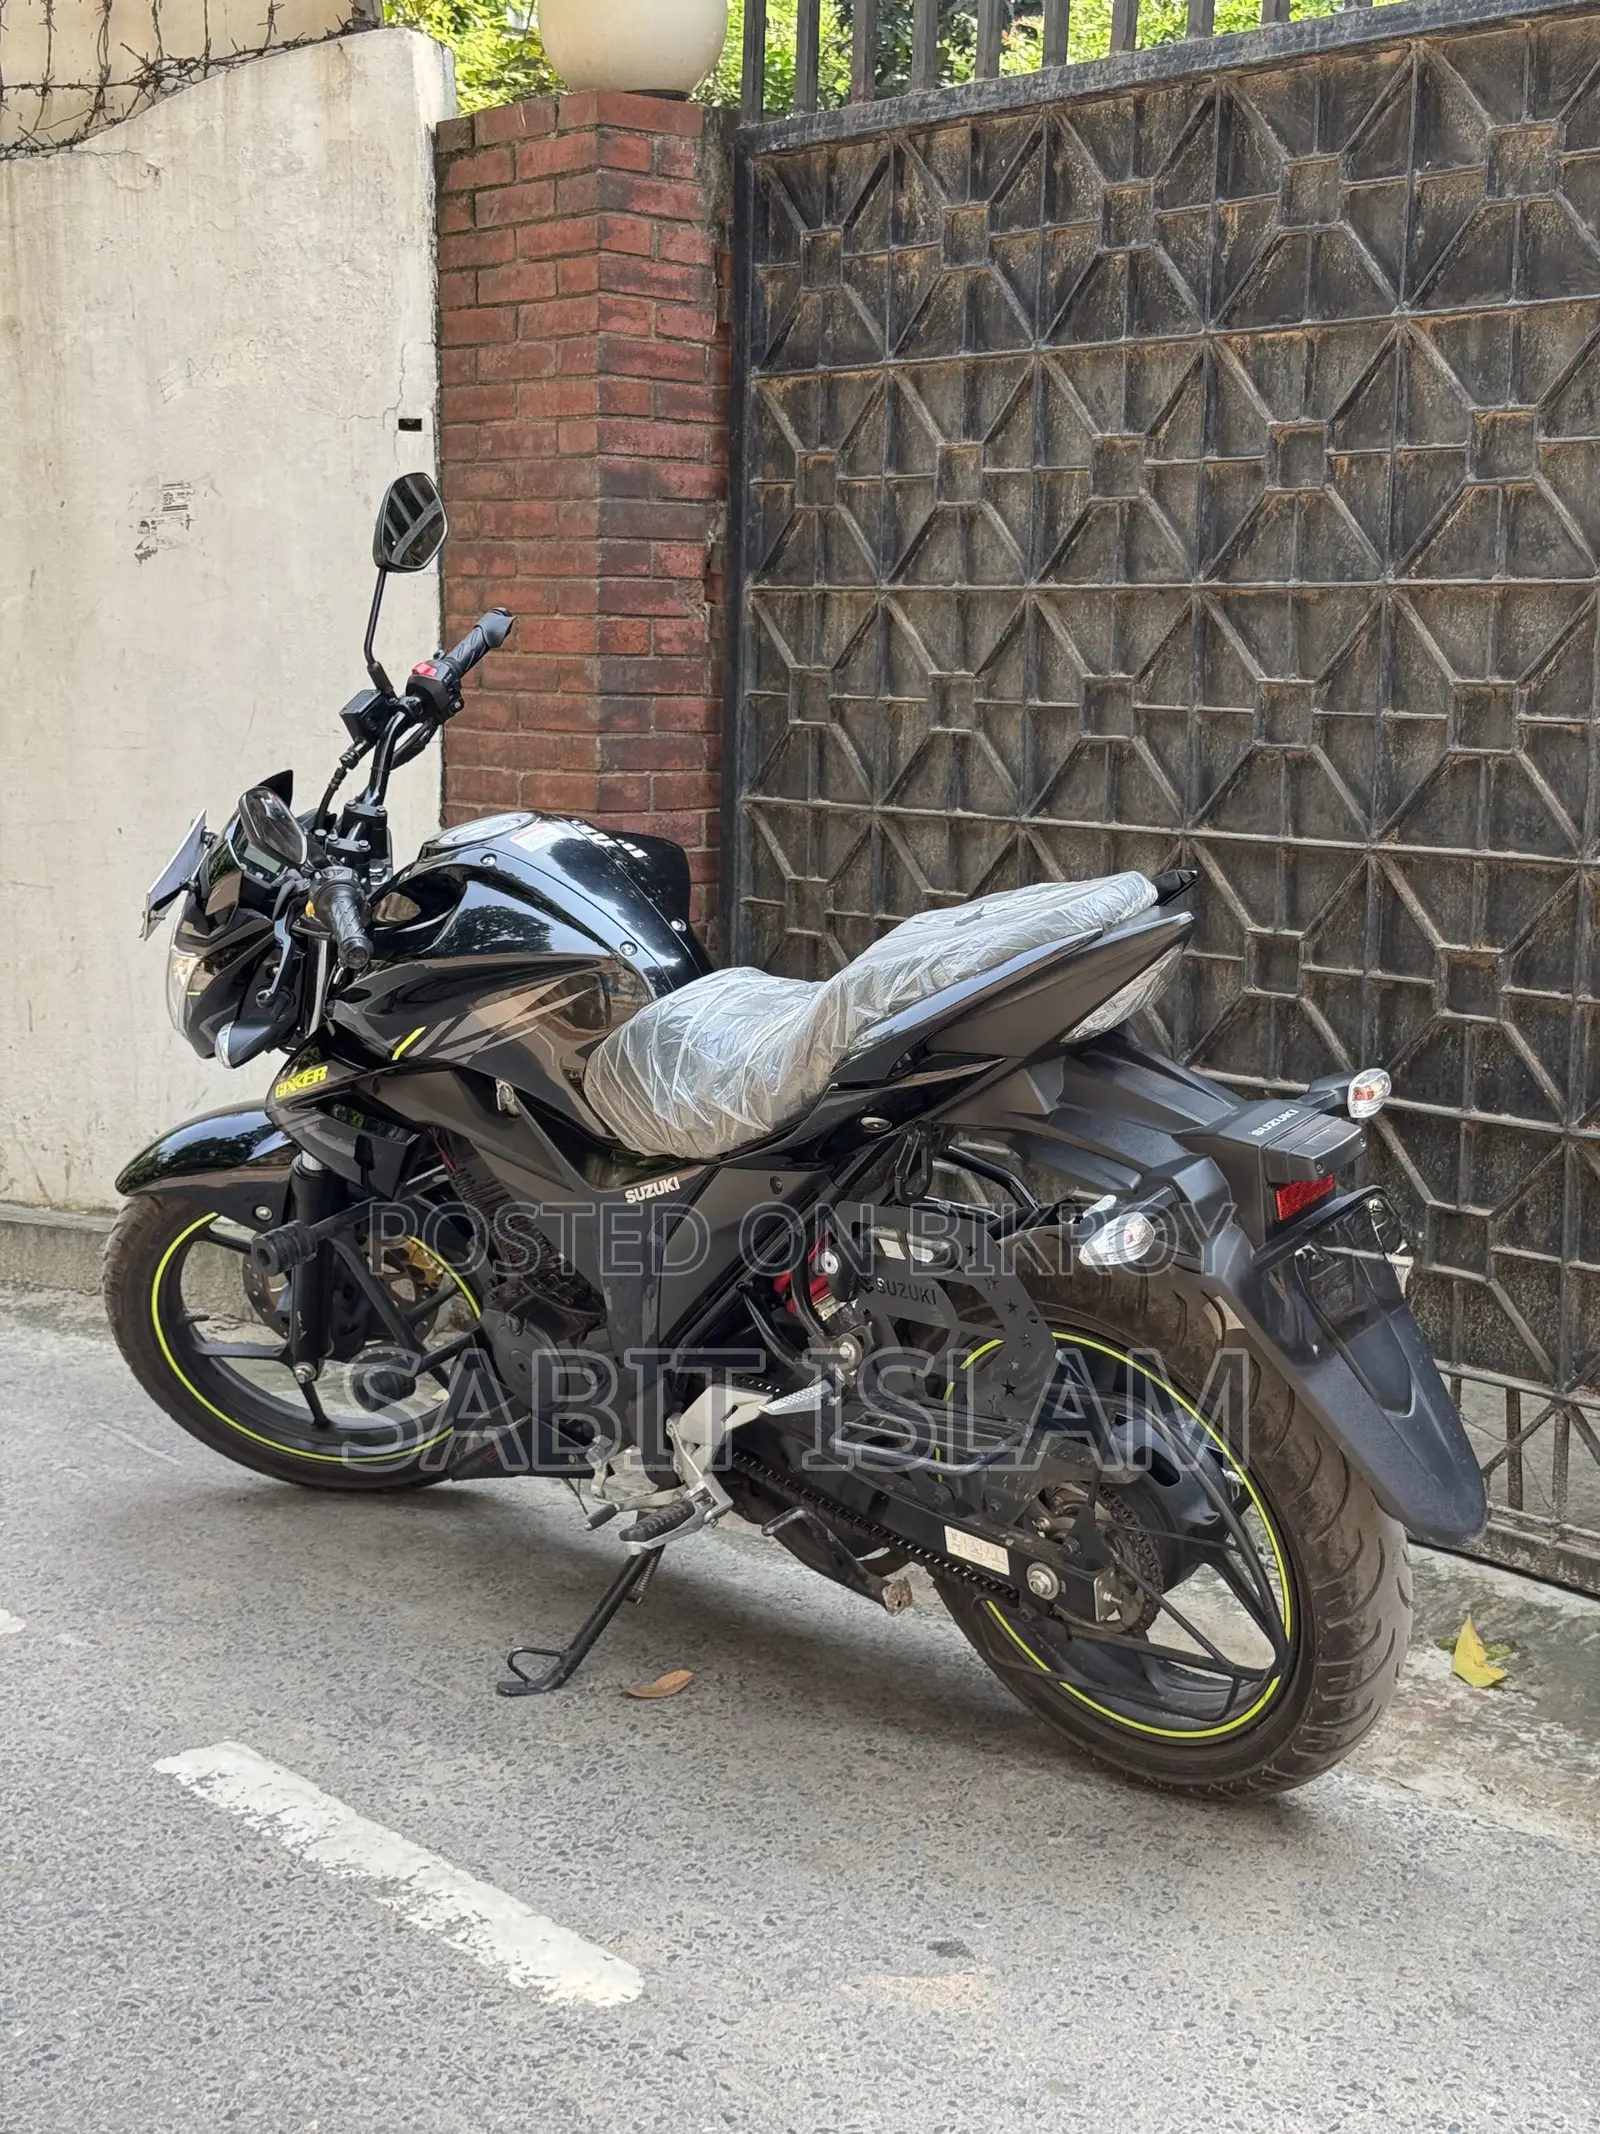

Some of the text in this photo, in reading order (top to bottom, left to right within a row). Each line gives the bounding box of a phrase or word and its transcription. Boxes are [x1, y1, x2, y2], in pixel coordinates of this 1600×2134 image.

[1250, 1108, 1300, 1136] SUZUKI
[624, 1175, 681, 1204] SUZUKI
[875, 1277, 937, 1305] SUZUKI
